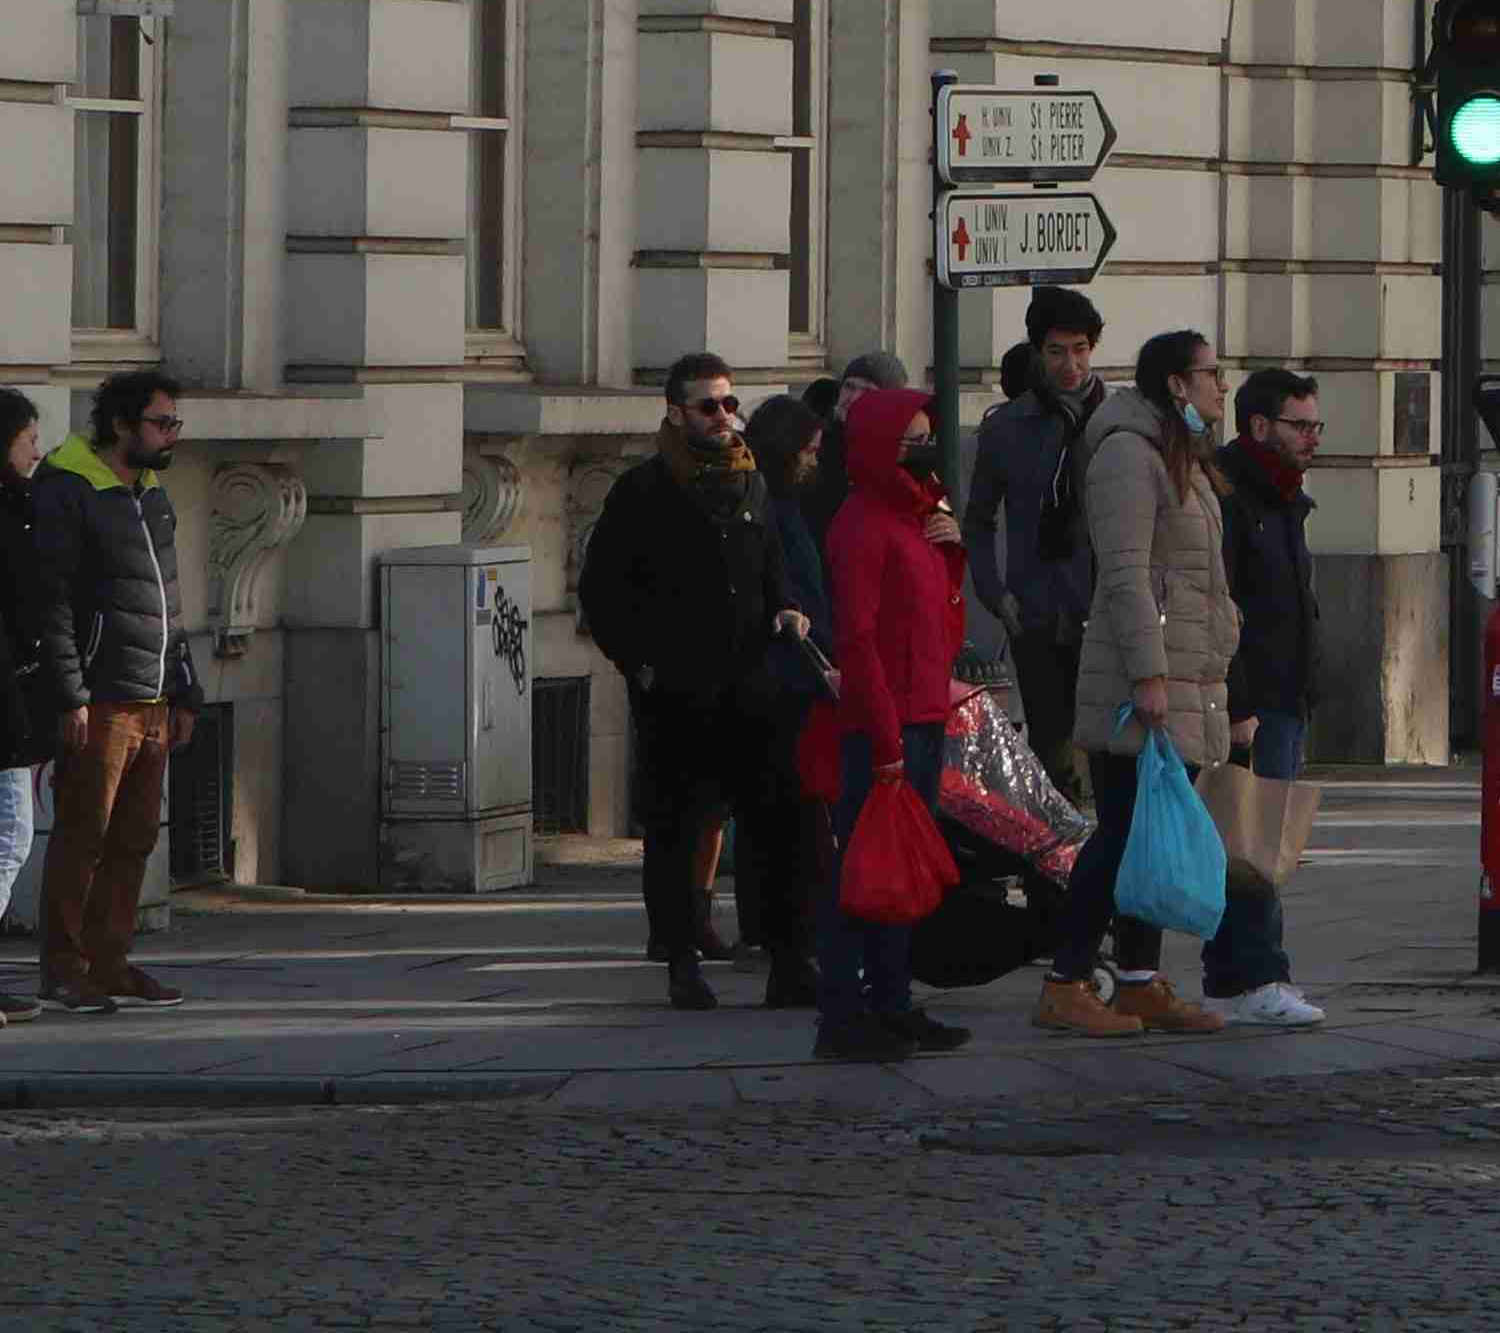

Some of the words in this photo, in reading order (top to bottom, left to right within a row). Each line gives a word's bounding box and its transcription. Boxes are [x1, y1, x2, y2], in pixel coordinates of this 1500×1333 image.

[1030, 102, 1042, 129] St
[1050, 102, 1084, 129] PIERRE
[1030, 134, 1042, 161] St
[1050, 134, 1085, 161] PIETER
[984, 204, 1009, 231] UNIV.
[1037, 213, 1090, 253] BORDET
[975, 237, 1000, 264] UNIV.
